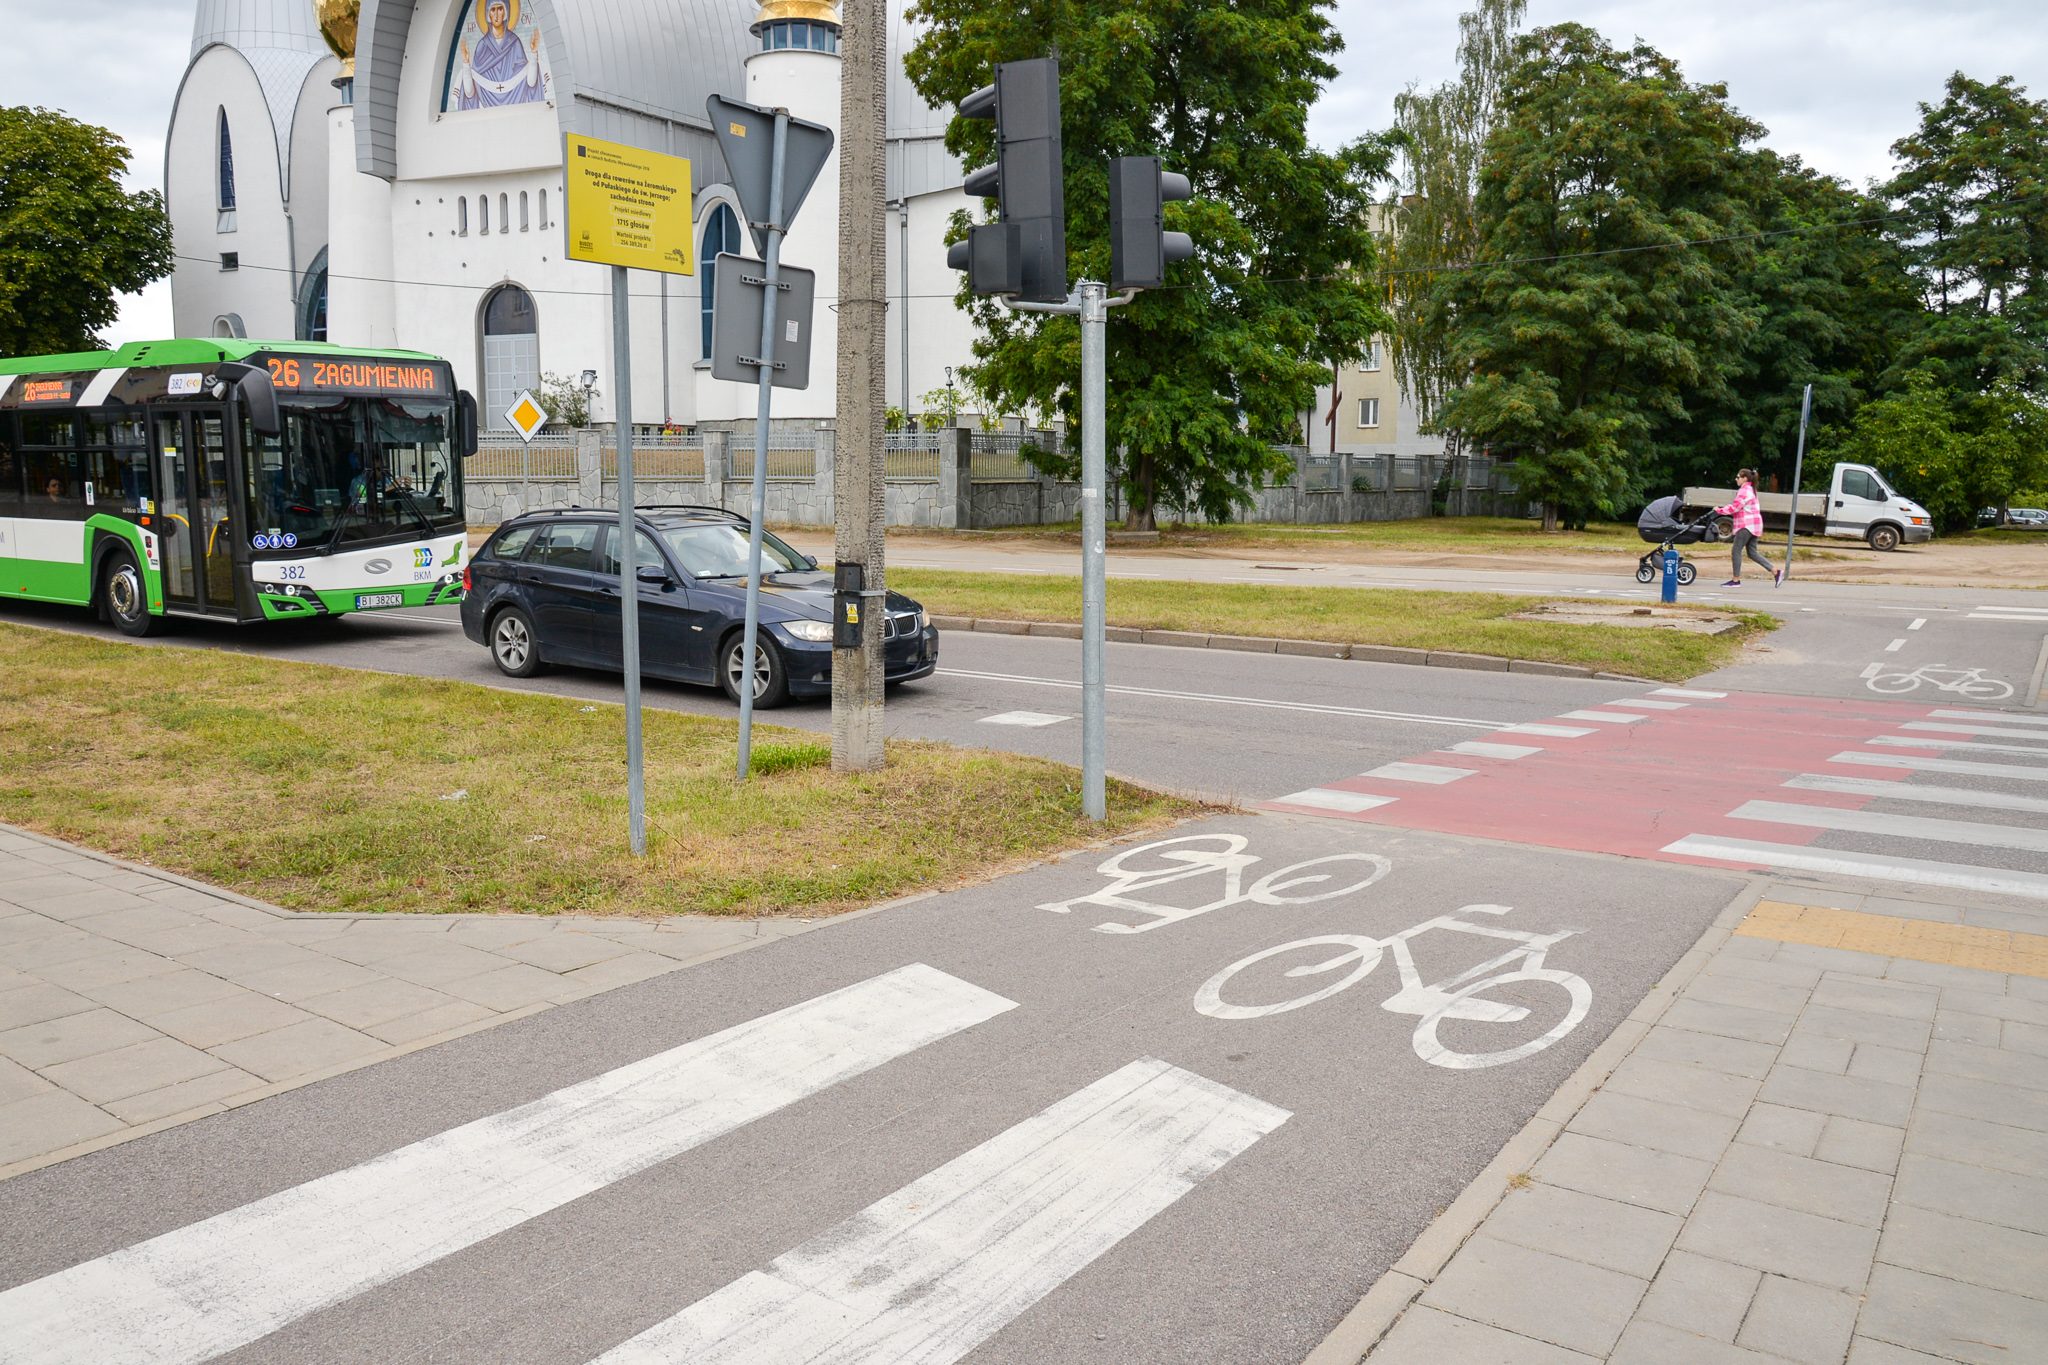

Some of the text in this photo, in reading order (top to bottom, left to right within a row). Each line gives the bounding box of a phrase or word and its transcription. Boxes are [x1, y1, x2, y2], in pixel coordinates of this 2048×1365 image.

[585, 168, 602, 179] Droga
[603, 172, 611, 180] dla
[613, 176, 635, 185] rowerów
[644, 180, 677, 194] Żeromskiego
[601, 181, 631, 194] Pułaskiego
[632, 187, 639, 195] do
[640, 189, 649, 197] św.
[610, 193, 655, 207] zachodnia strona
[614, 205, 652, 218] Projekt osiedlowy
[617, 218, 650, 229] 1715 głosów
[616, 231, 652, 242] Wartość projektu
[267, 358, 434, 390] 26 ZAGUMIENNA
[171, 378, 183, 390] 382
[24, 382, 37, 402] 26
[280, 565, 306, 580] 382
[413, 570, 432, 581] BKM
[361, 594, 401, 606] BI 382CK
